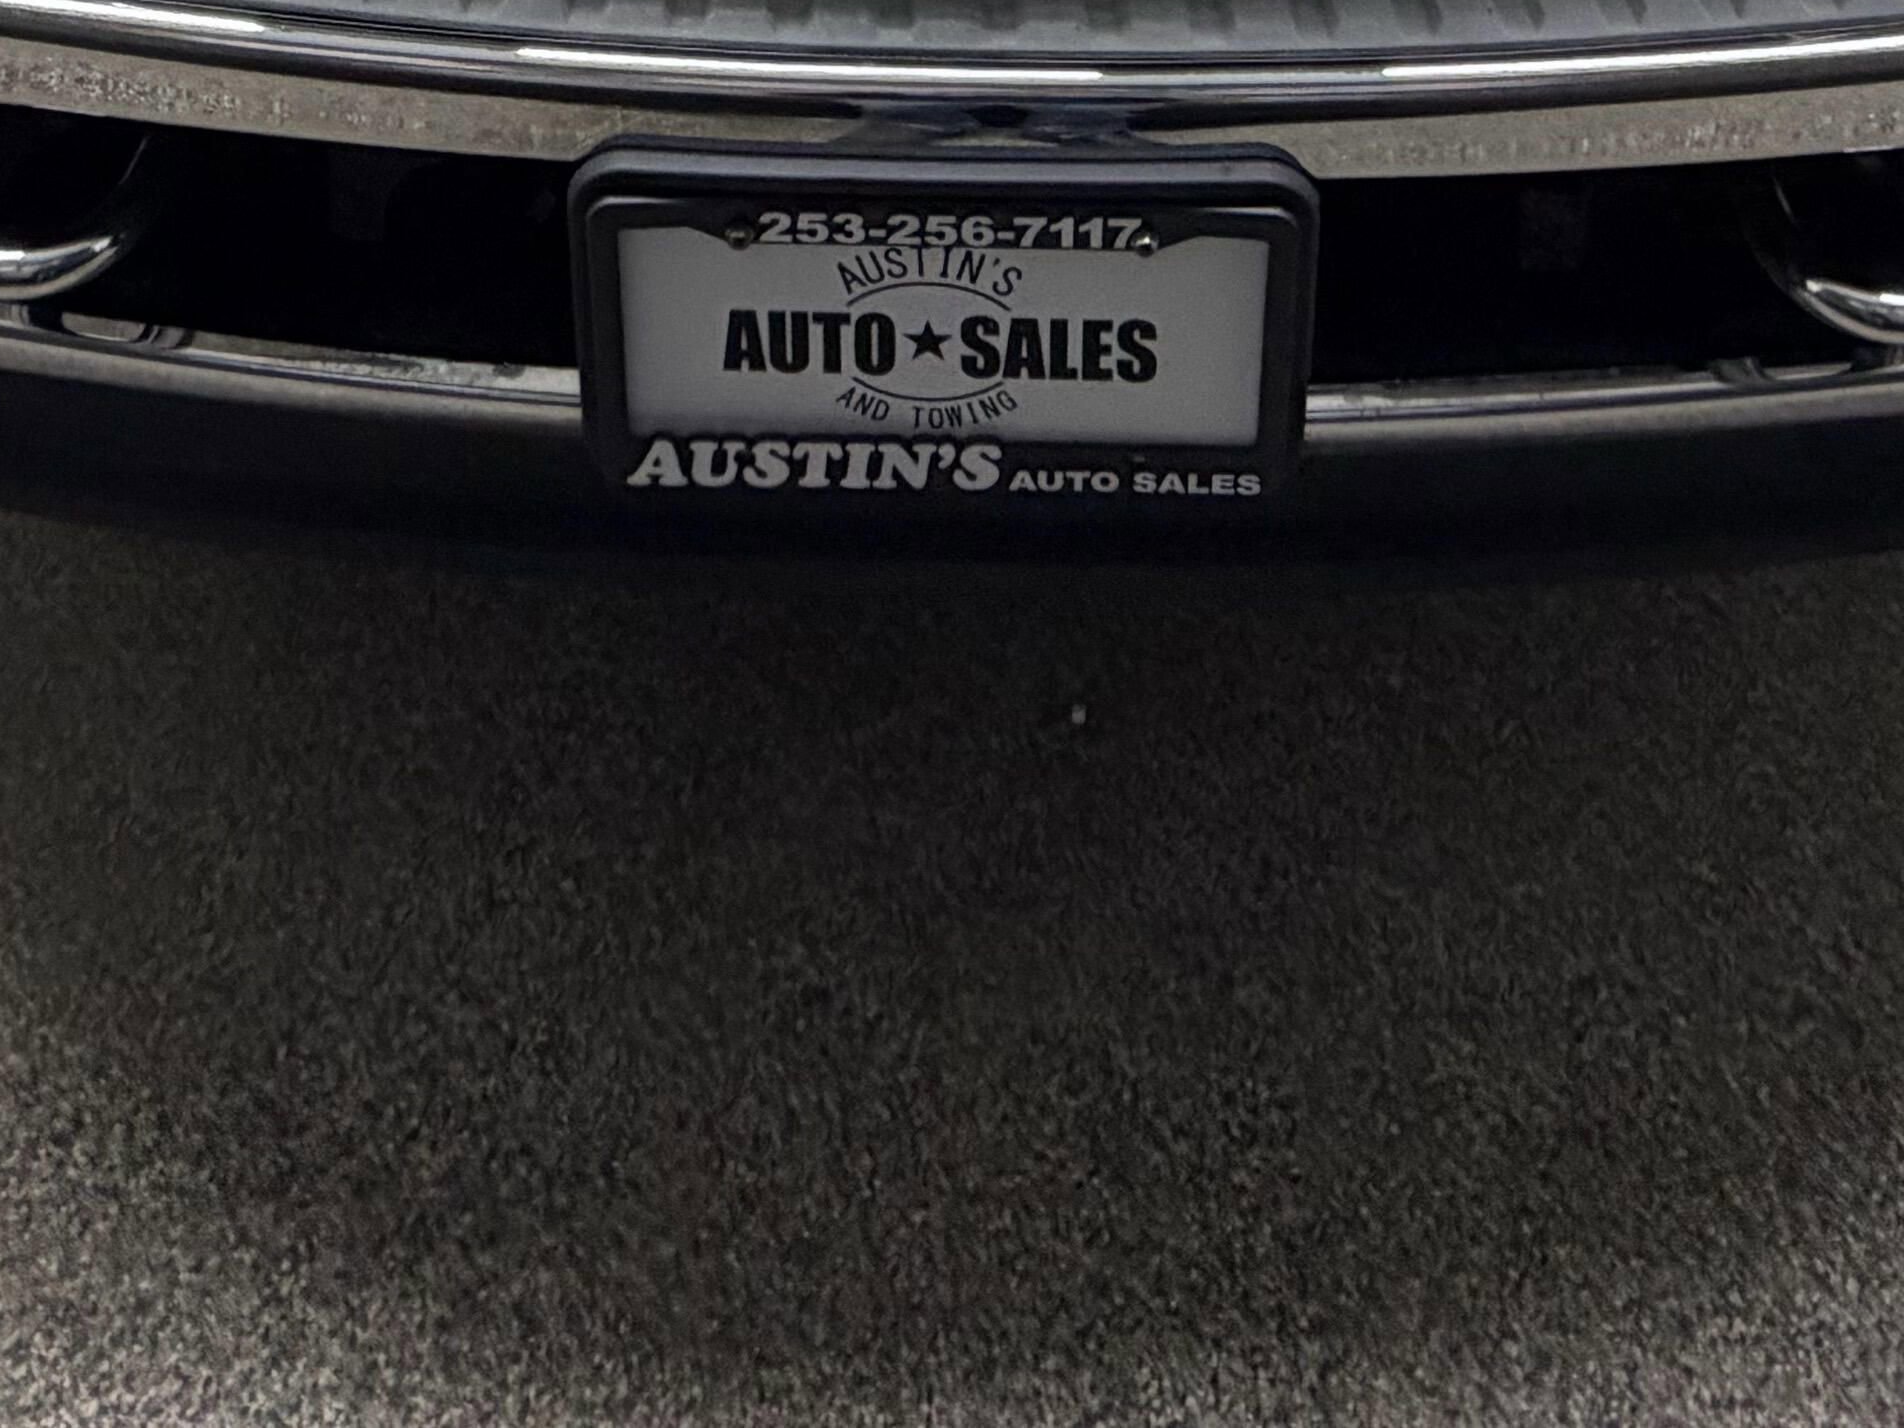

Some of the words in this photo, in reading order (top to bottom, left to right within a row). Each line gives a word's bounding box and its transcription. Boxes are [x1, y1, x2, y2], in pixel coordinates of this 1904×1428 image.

[758, 211, 1143, 249] 253-256-7117
[836, 246, 1023, 296] AUSTIN'S
[722, 308, 897, 376] AUTO
[959, 314, 1159, 384] SALES
[835, 385, 891, 422] AND
[911, 388, 1019, 430] TOWING
[627, 438, 1003, 493] AUSTIN'S
[1008, 468, 1120, 495] AUTO
[1132, 471, 1262, 497] SALES
